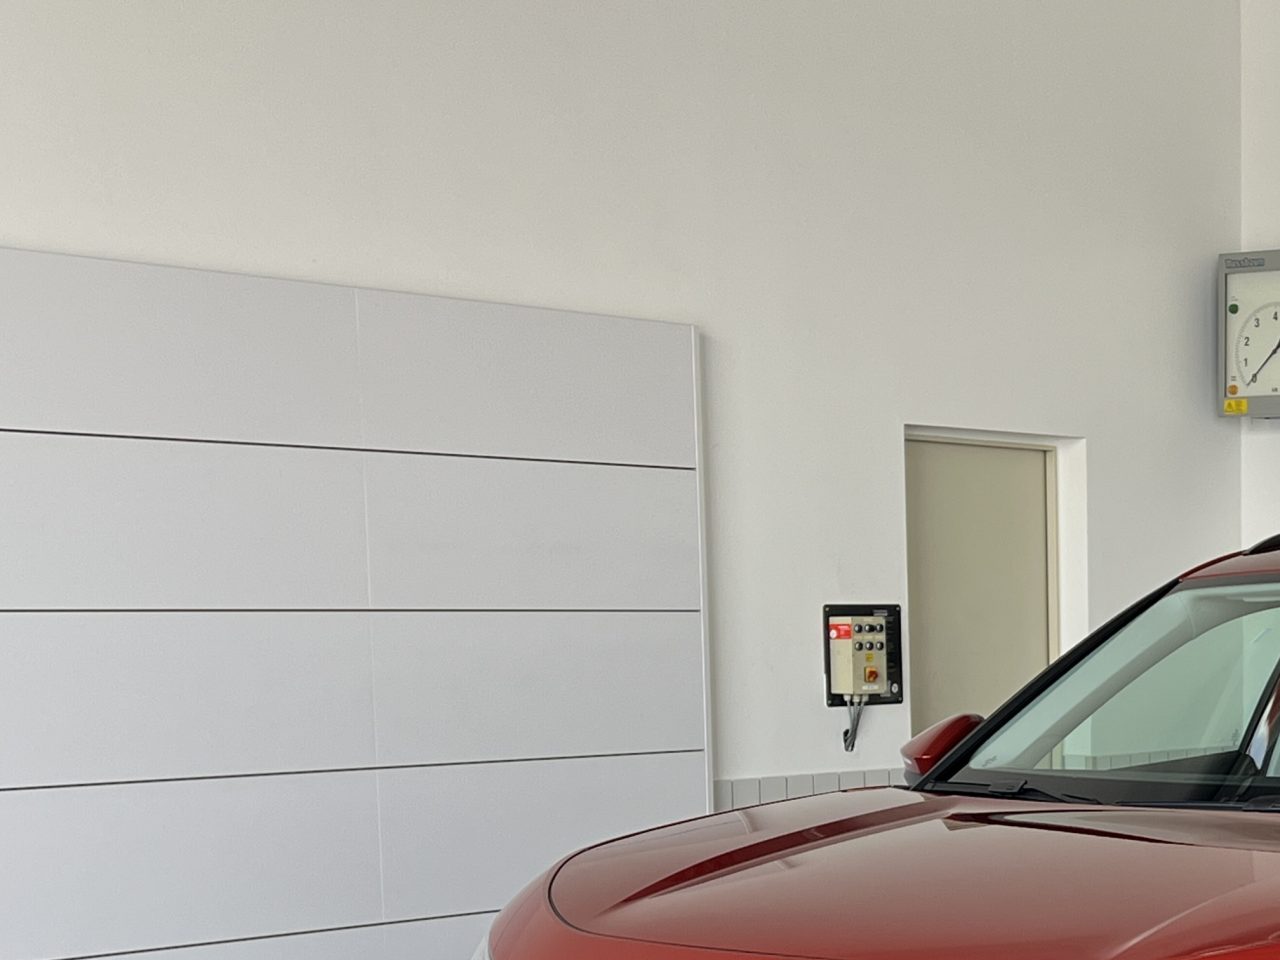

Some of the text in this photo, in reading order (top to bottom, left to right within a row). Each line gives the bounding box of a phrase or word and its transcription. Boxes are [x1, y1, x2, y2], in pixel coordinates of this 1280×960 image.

[1272, 311, 1278, 321] 4
[1254, 318, 1260, 327] 3
[1244, 337, 1250, 346] 2
[1243, 358, 1248, 367] 1
